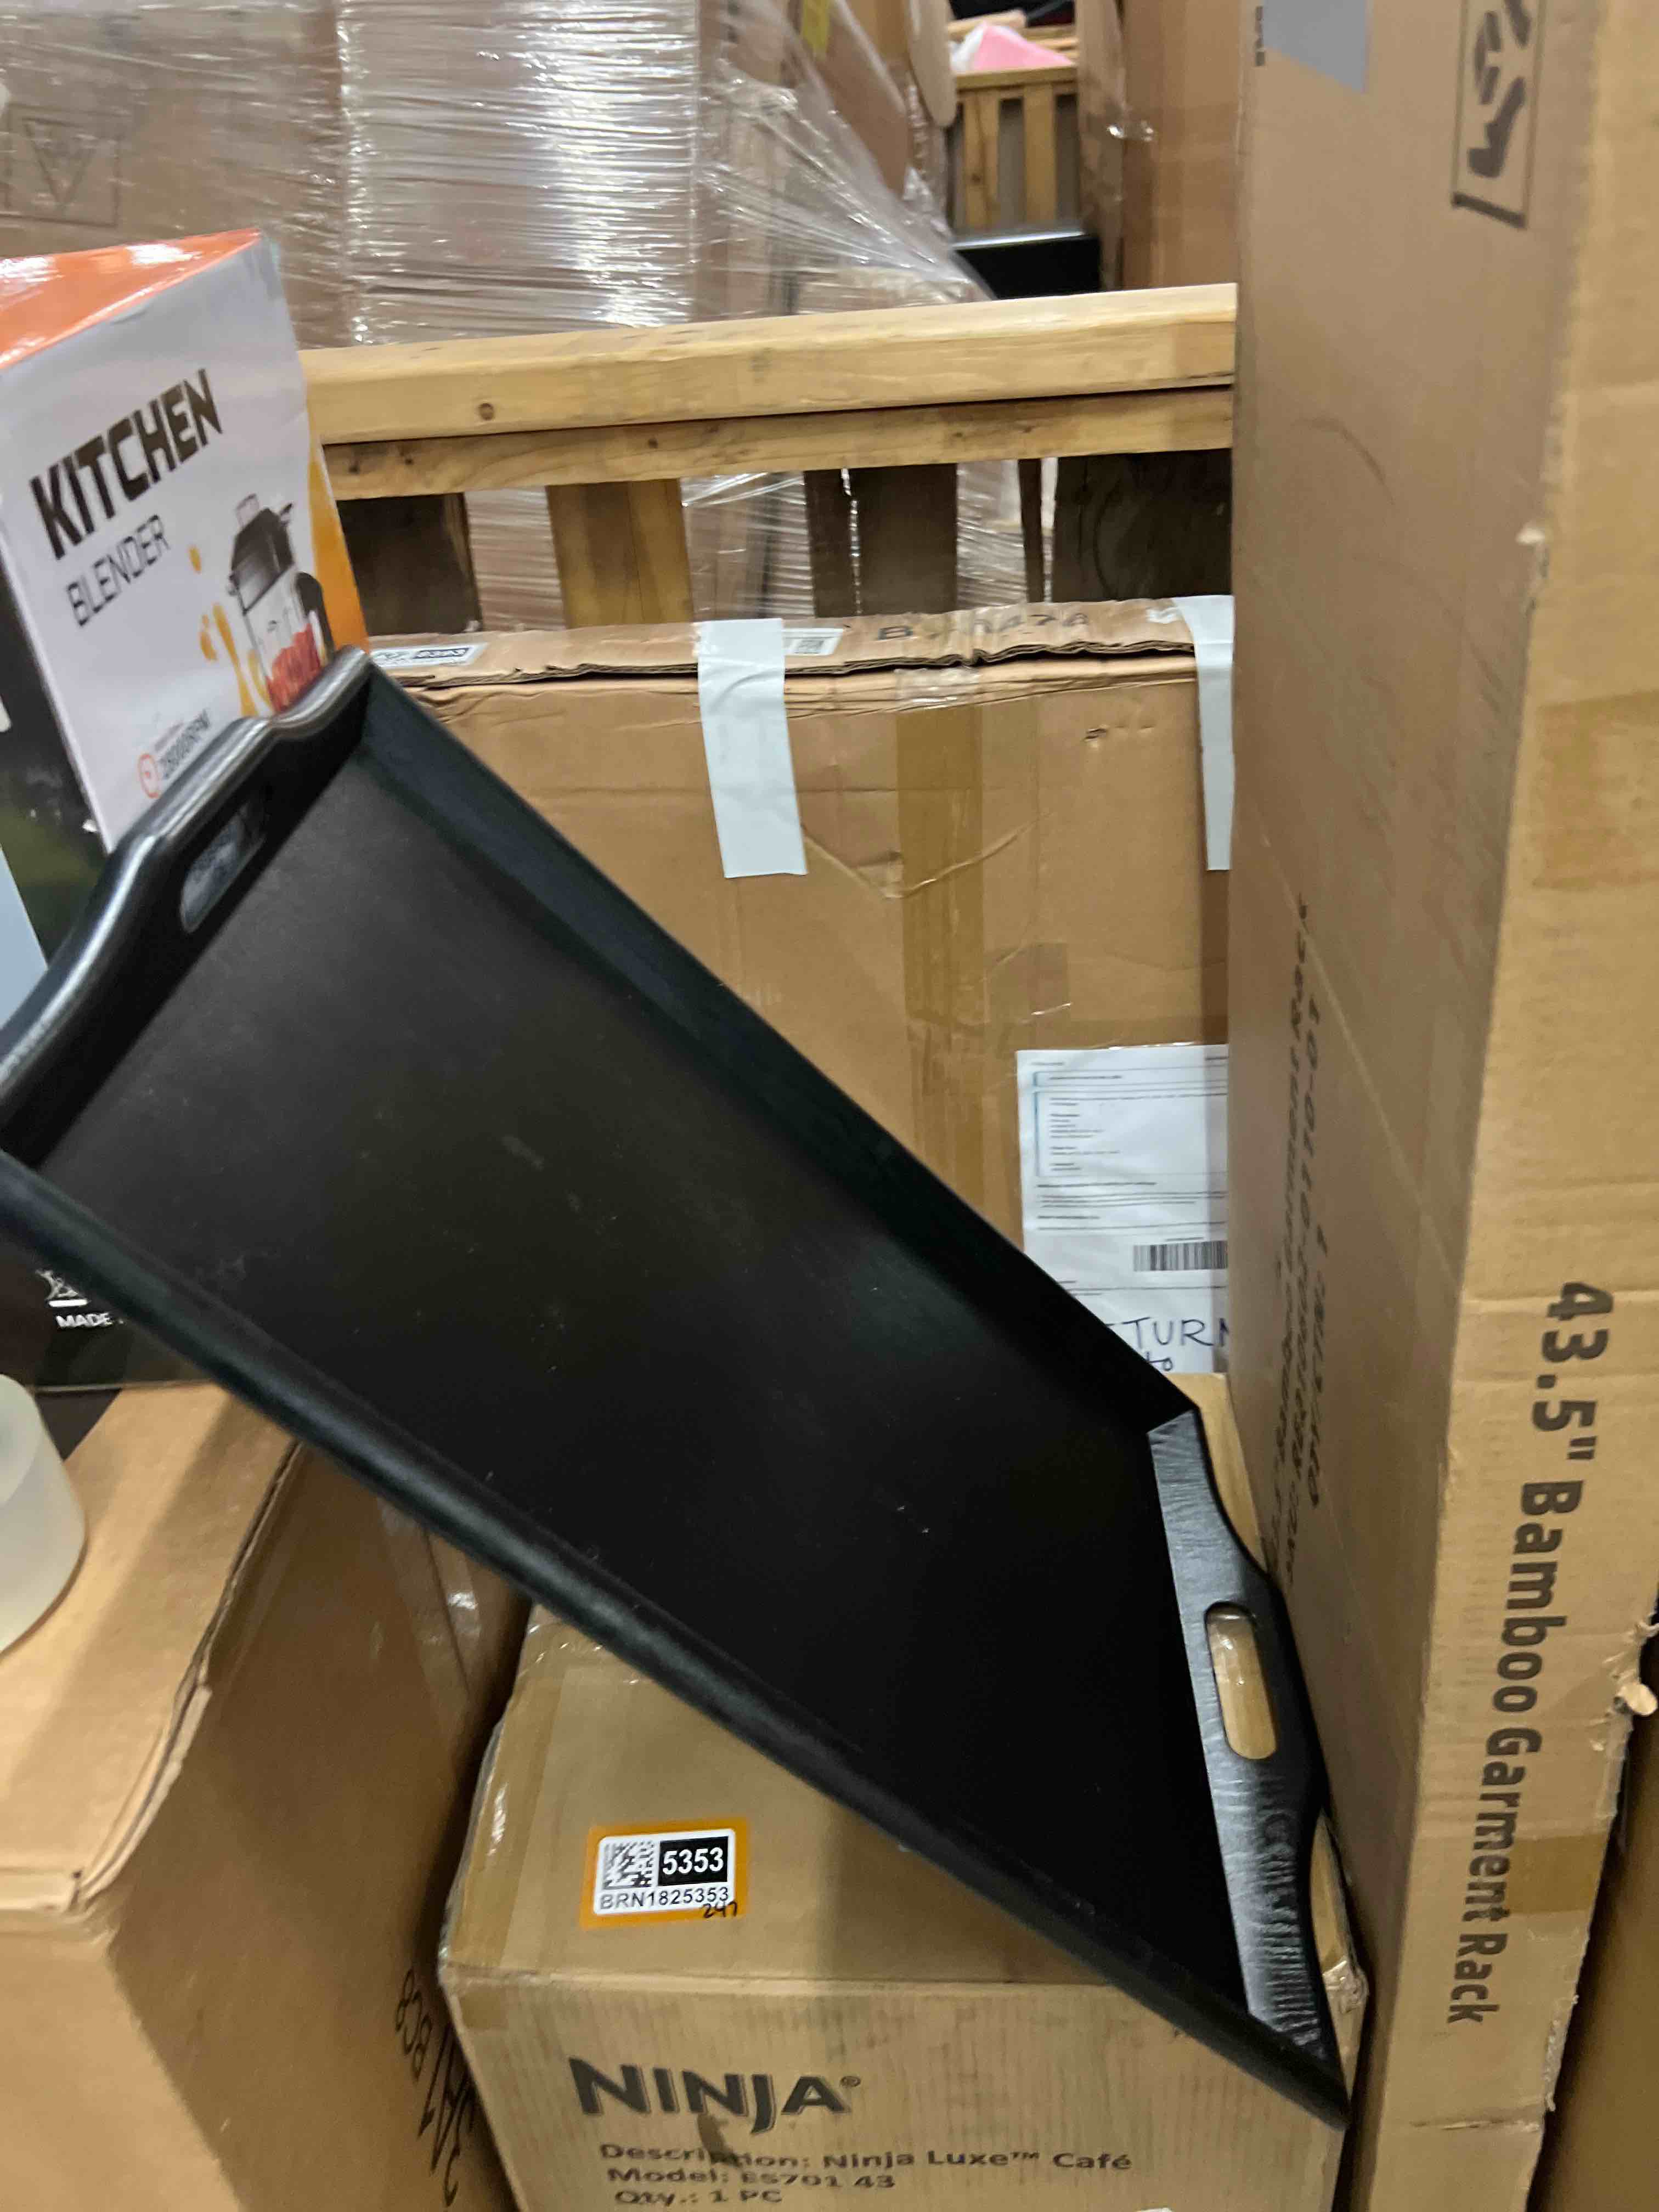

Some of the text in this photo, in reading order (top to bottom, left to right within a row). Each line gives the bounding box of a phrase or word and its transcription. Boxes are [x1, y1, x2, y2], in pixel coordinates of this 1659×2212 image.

[30, 369, 224, 561] KITCHEN
[66, 514, 171, 628] BLENDER
[55, 1312, 113, 1330] MADE
[1105, 1316, 1229, 1349] TUR
[1493, 1480, 1584, 1713] Bamboo
[1462, 1729, 1542, 1921] Garment
[662, 1847, 725, 1876] 5353
[600, 1887, 729, 1910] BRN1825353
[1447, 1932, 1508, 2025] Rack
[601, 2144, 811, 2167] Descriion:
[823, 2152, 915, 2171] Ninja
[1053, 2152, 1133, 2170] Café
[607, 2168, 729, 2183] Model:
[711, 2190, 729, 2202] 1
[740, 2189, 783, 2203] PC
